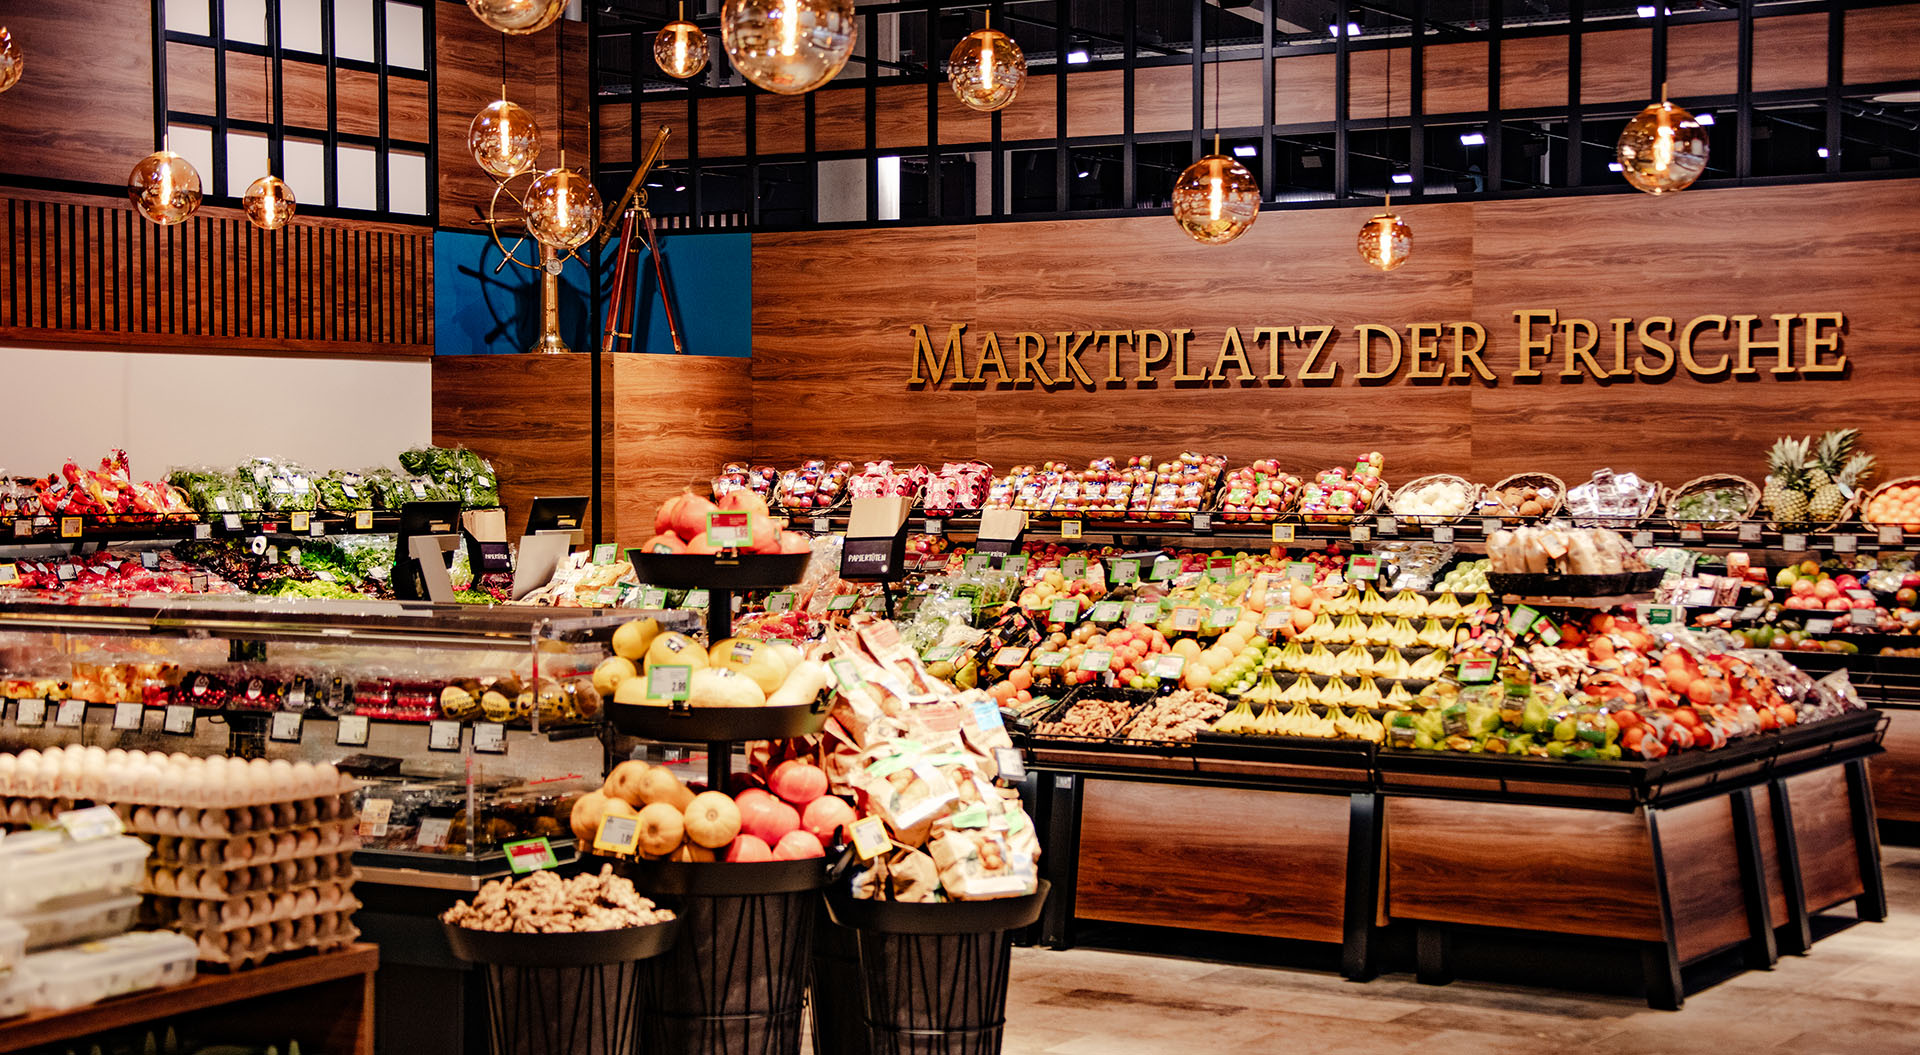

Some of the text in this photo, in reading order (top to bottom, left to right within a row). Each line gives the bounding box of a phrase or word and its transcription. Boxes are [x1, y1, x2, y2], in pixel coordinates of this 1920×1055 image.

[906, 309, 1847, 386] MARKTPLATZ DER FRISCHE
[848, 553, 887, 562] PAPIERTÜTEN
